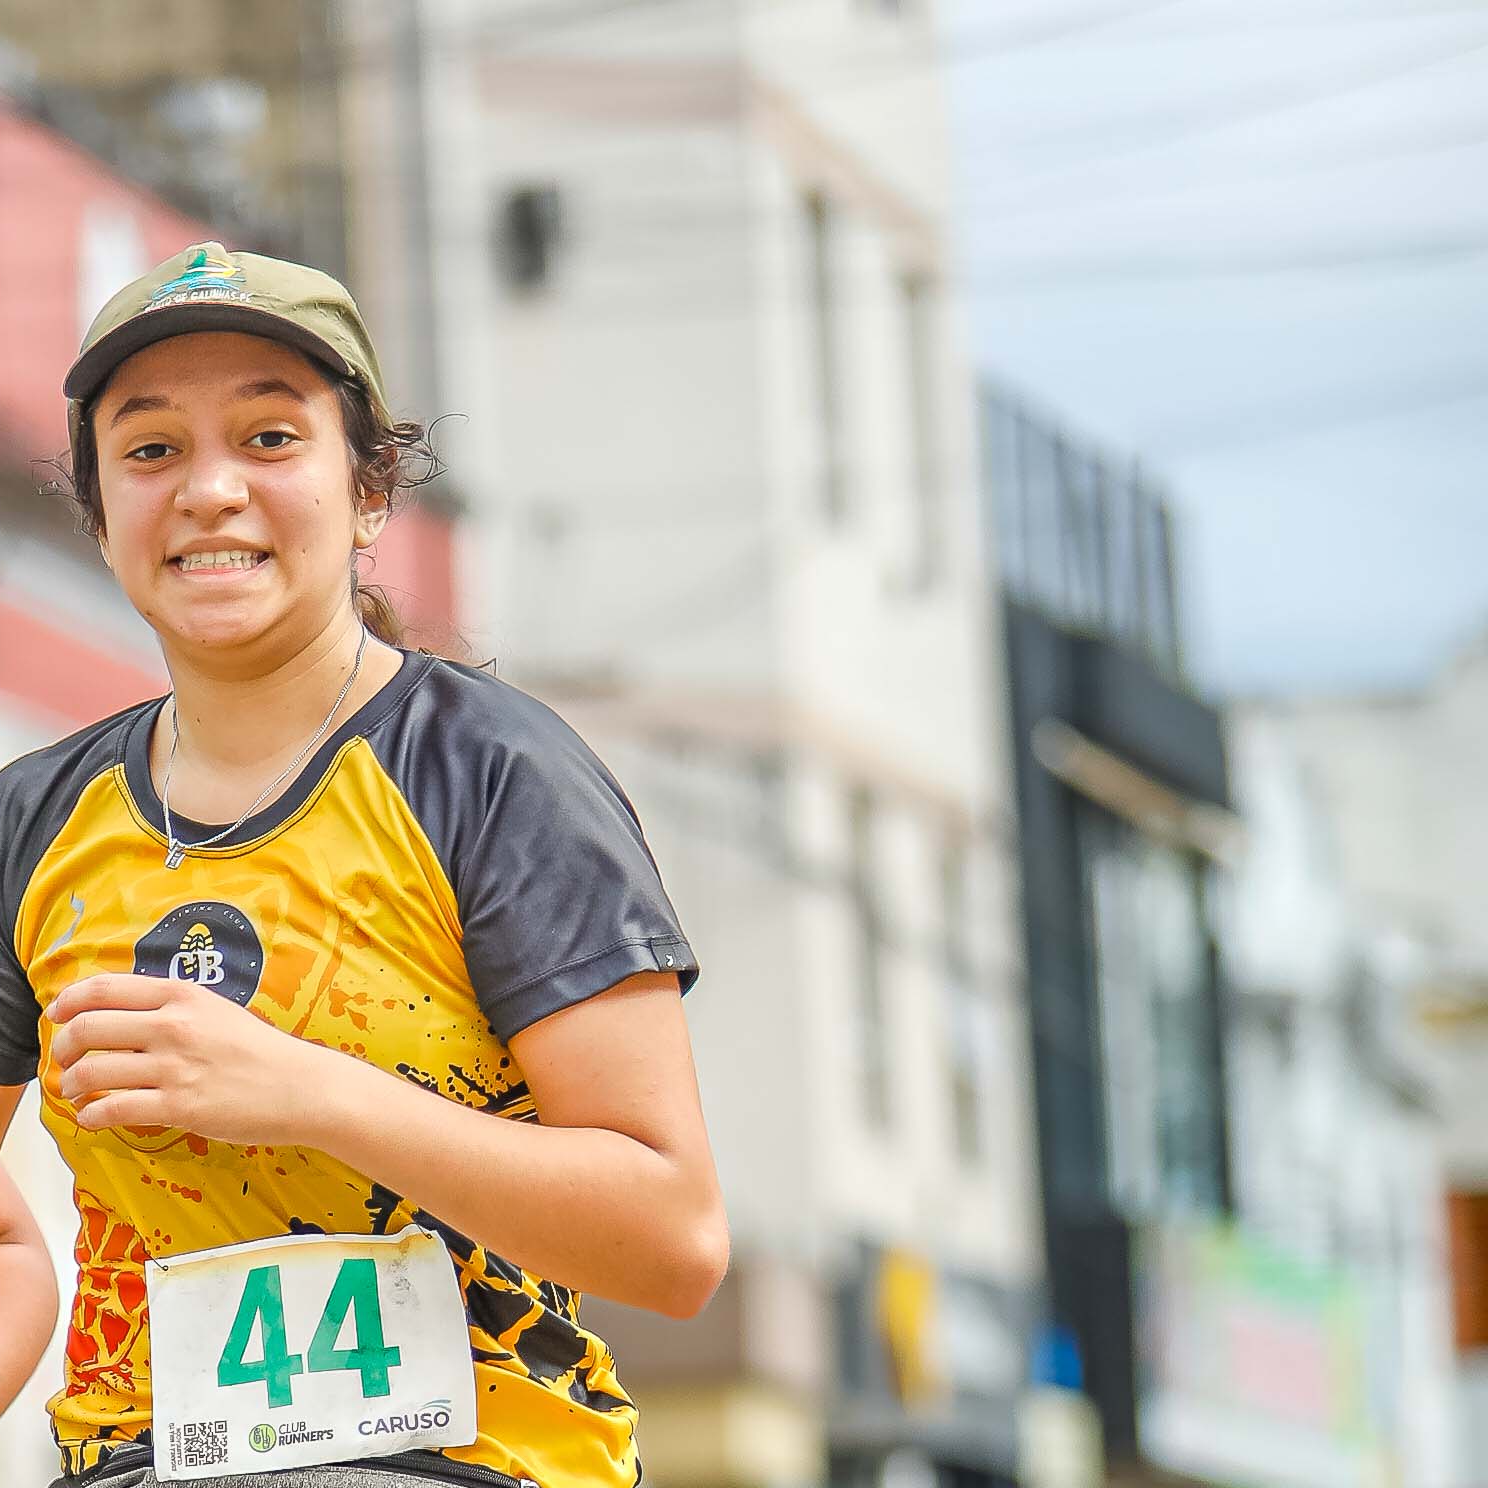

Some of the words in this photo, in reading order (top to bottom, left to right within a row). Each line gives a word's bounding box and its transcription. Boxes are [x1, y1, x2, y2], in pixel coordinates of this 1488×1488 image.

[168, 949, 225, 985] CB
[217, 1258, 402, 1409] 44
[278, 1421, 307, 1434] CLUB
[357, 1411, 450, 1436] CARUSO
[278, 1429, 334, 1446] RUNNER'S
